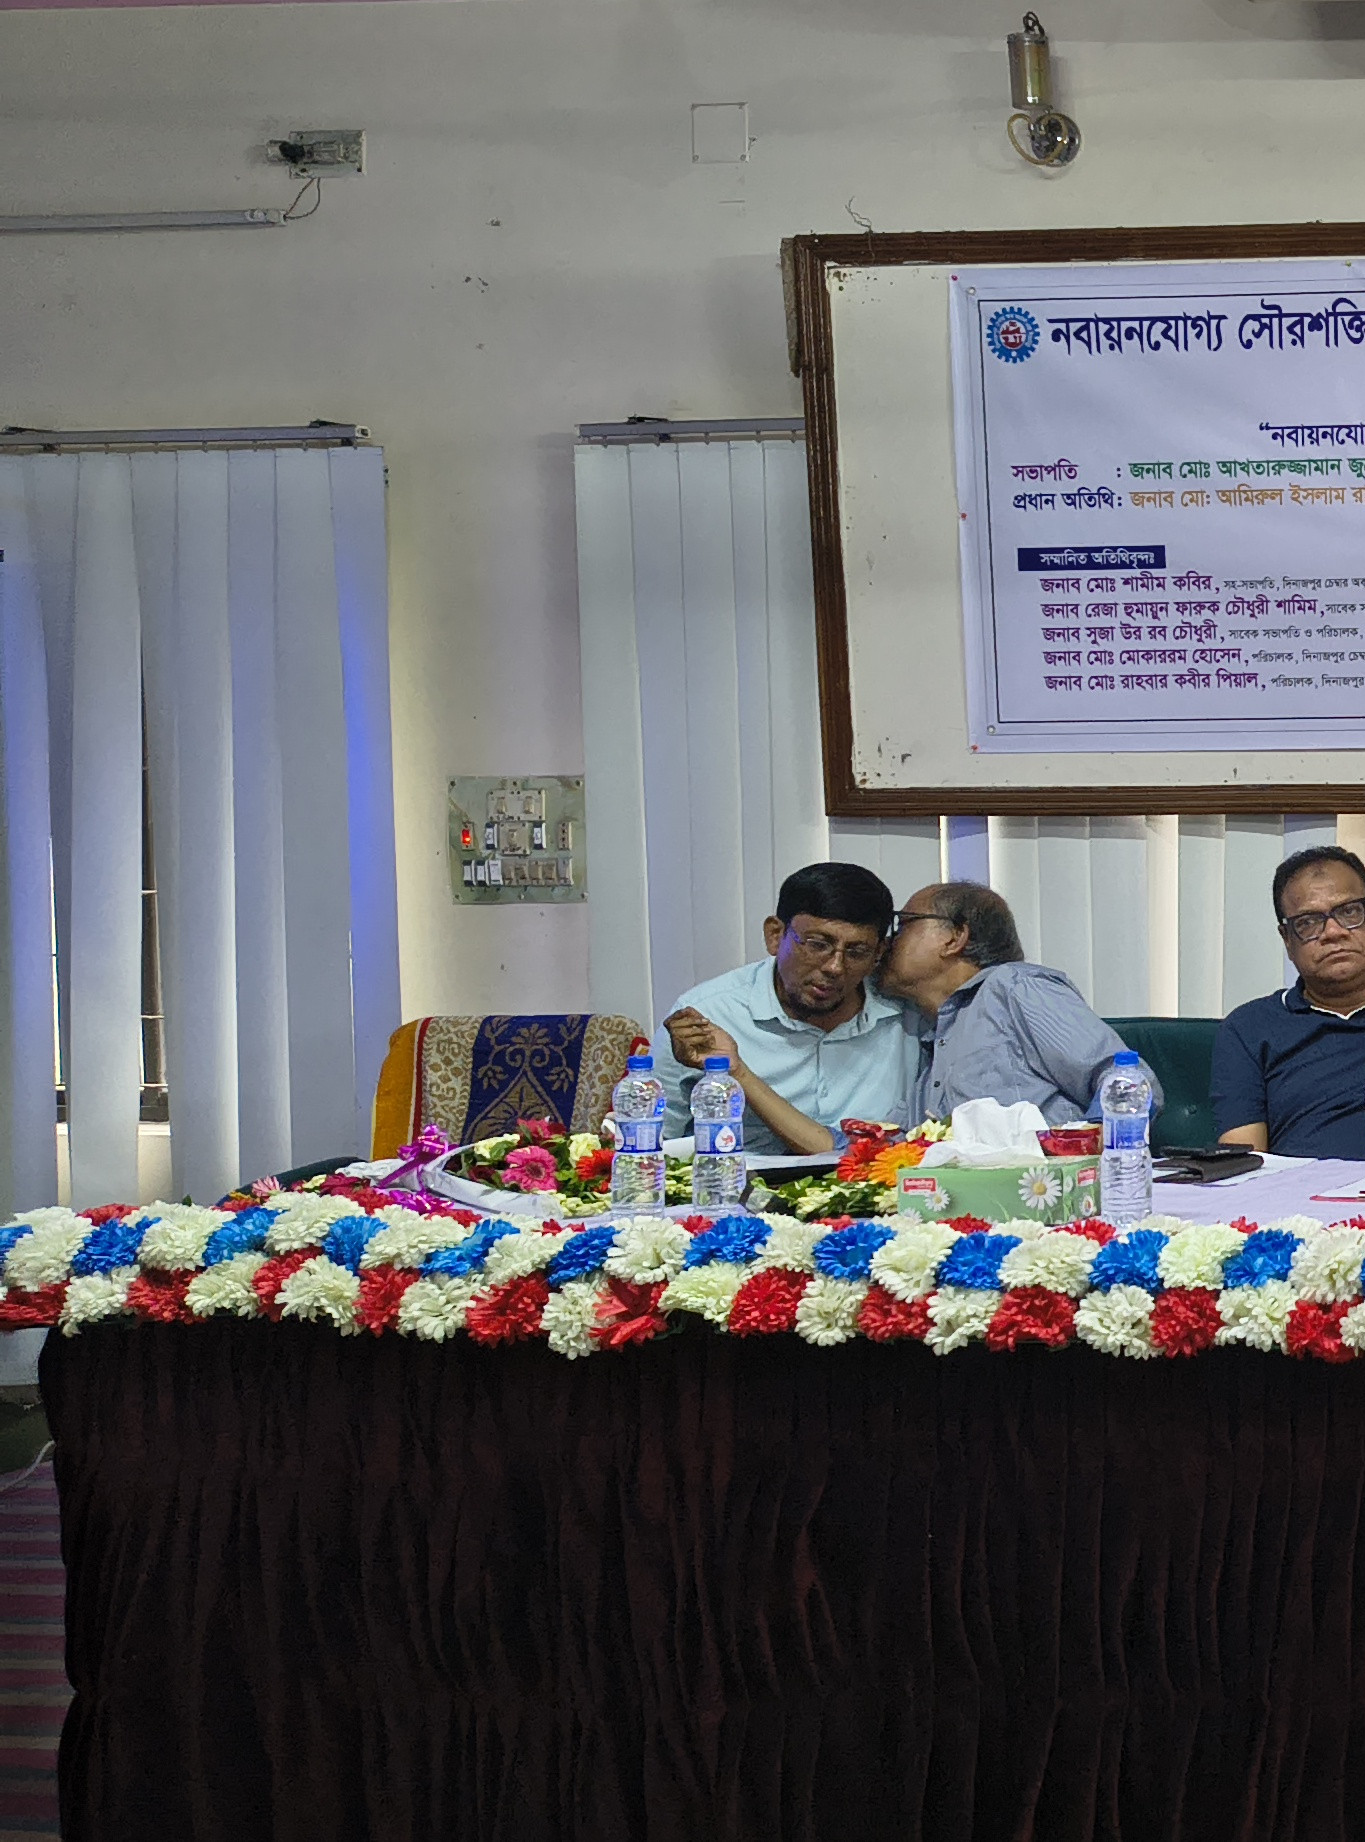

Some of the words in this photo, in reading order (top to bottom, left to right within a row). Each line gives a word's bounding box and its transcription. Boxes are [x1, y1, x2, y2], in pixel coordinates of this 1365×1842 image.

[1048, 309, 1228, 355] নবায়নযোগ্য
[1010, 457, 1079, 482] সভাপতি
[1127, 460, 1174, 480] জনাব
[1215, 457, 1343, 478] আখতারুজ্জামান
[1012, 492, 1057, 512] প্রধান
[1128, 489, 1175, 508] জনাব
[1214, 483, 1284, 506] আমিরুল
[1287, 482, 1346, 506] ইসলাম
